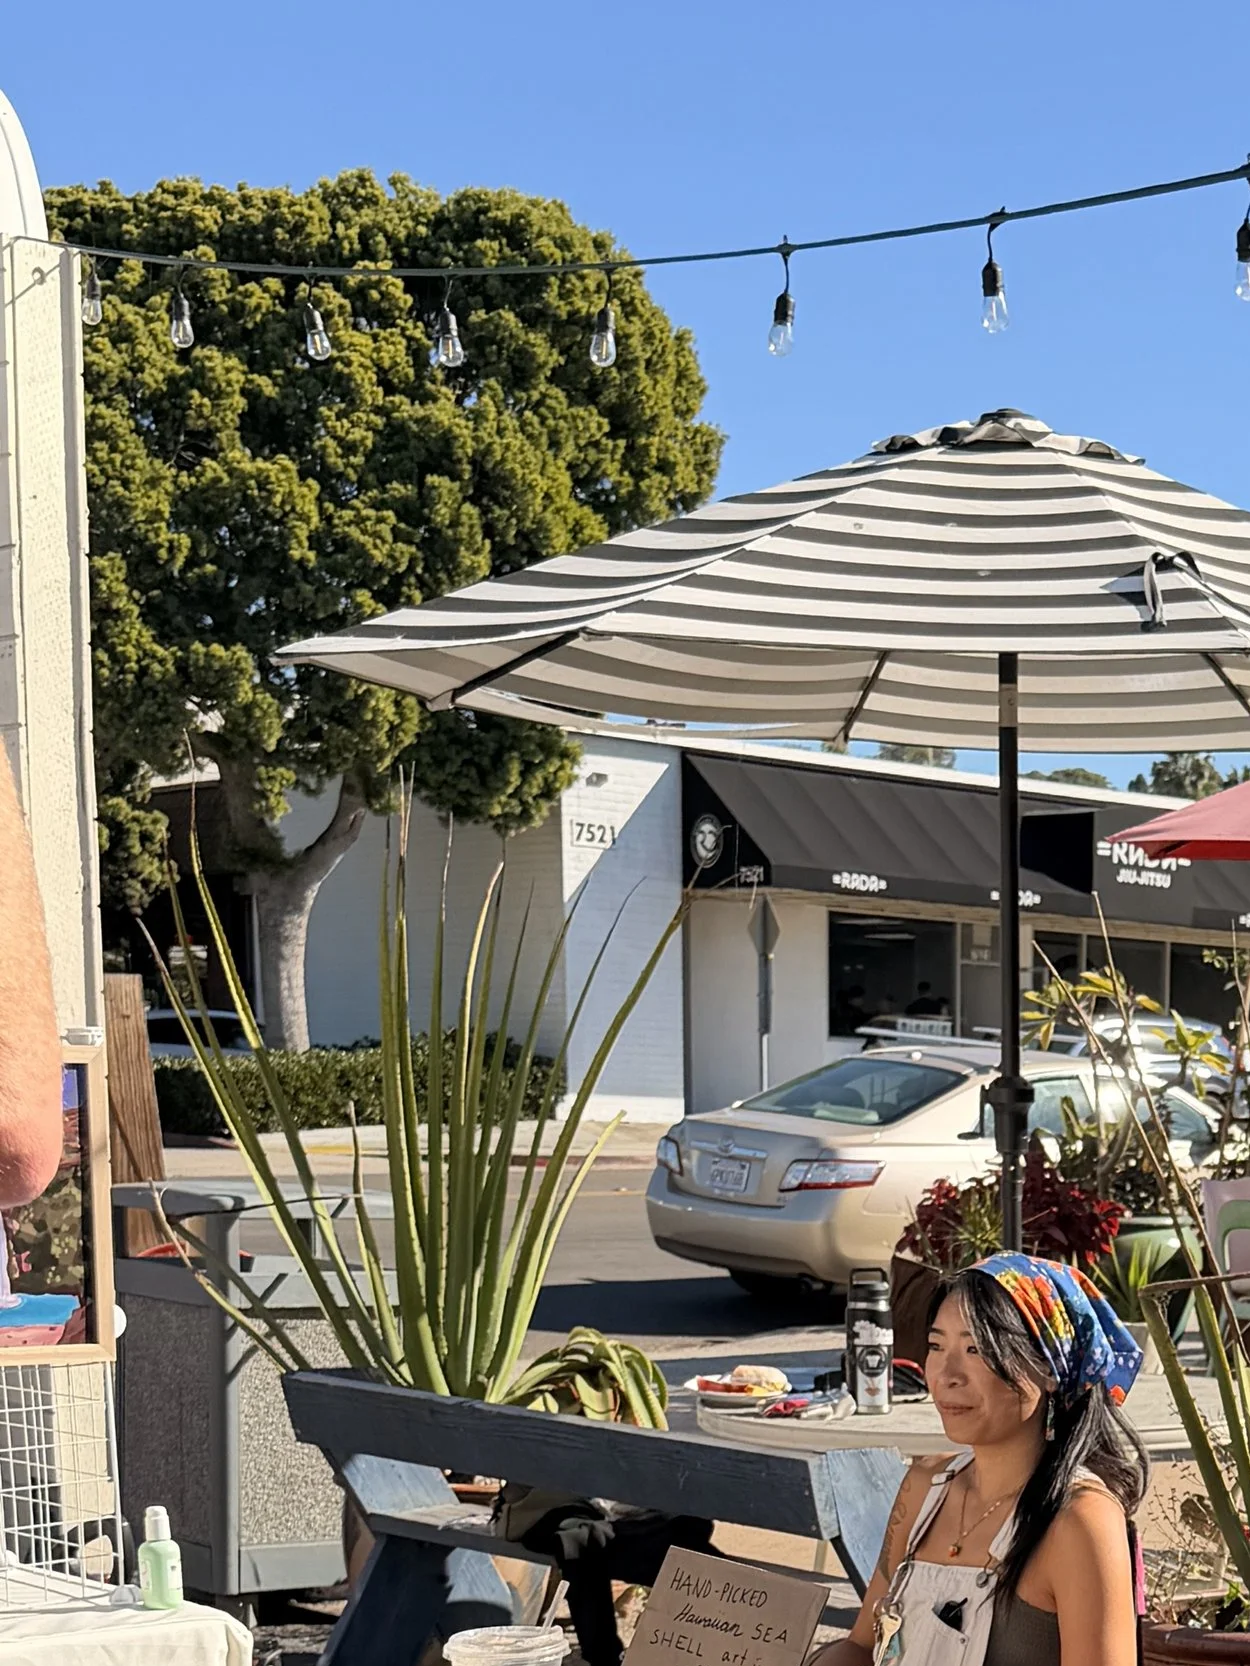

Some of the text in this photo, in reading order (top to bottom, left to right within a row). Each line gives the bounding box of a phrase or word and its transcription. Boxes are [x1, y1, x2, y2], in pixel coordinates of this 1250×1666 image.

[575, 822, 616, 845] 7521
[669, 1567, 768, 1608] HAND-PICKED
[650, 1629, 748, 1666] SHELL art
[751, 1623, 787, 1644] SEA
